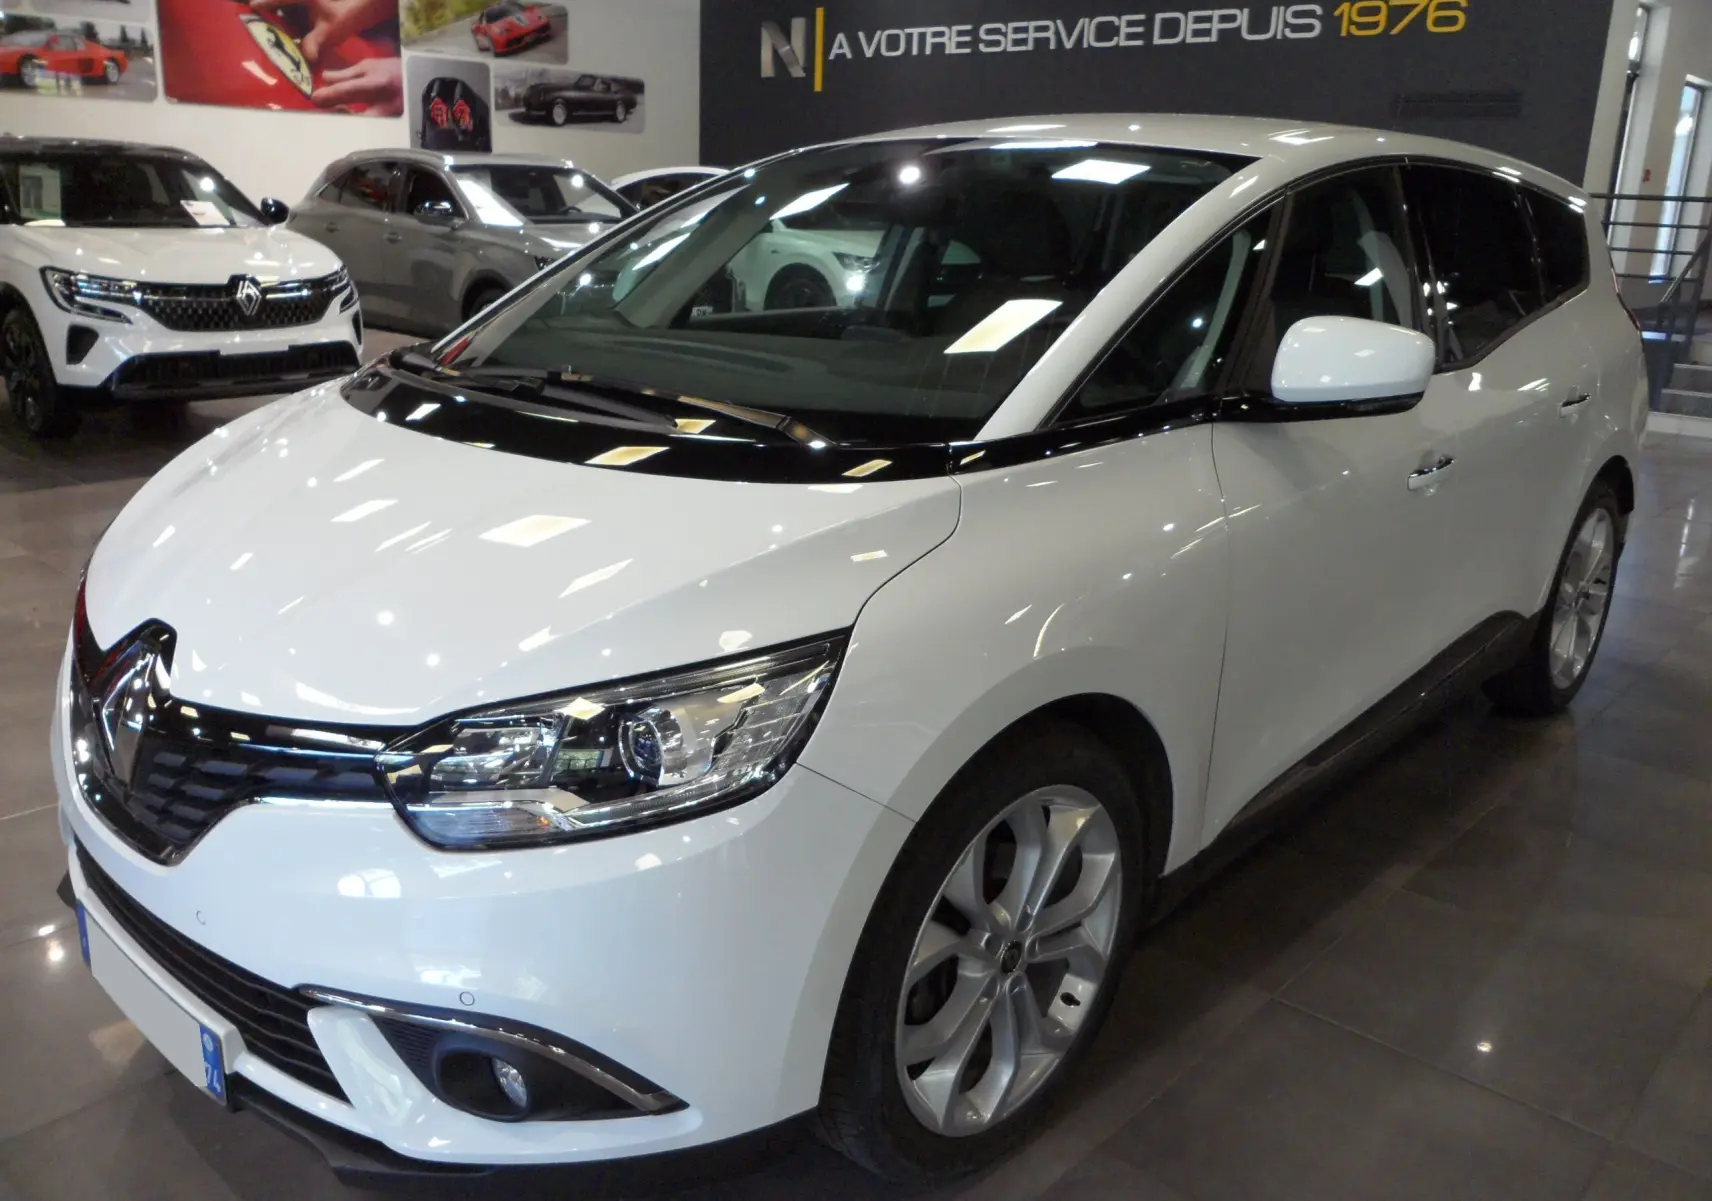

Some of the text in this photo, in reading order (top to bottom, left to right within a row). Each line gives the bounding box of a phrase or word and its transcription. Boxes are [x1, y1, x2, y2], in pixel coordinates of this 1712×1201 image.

[760, 17, 806, 78] N
[828, 0, 1469, 60] A VOTRE SERVICE DEPUIS 1976
